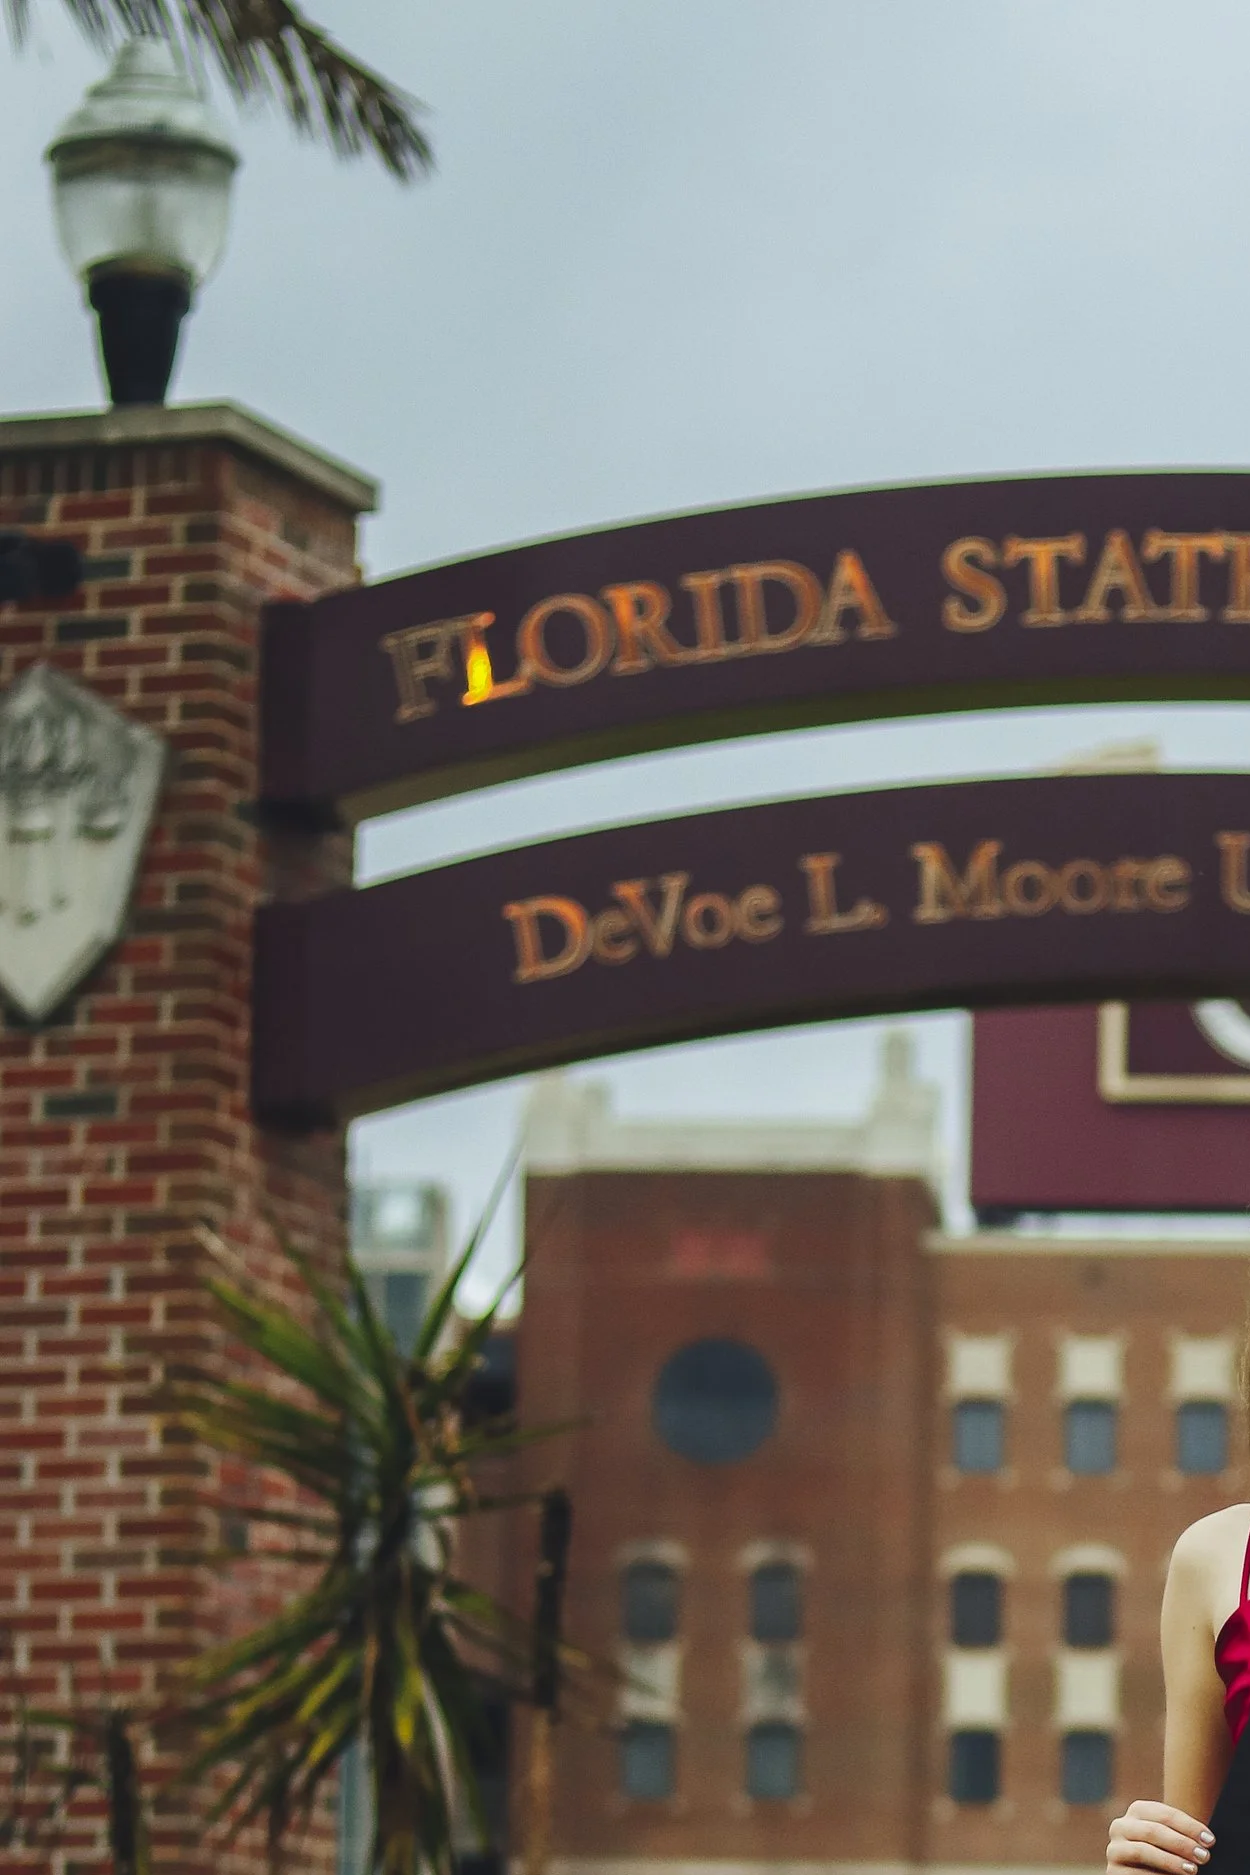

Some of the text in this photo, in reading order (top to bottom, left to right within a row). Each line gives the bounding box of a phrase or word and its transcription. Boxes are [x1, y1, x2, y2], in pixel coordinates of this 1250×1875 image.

[381, 550, 897, 724] FLORIDA
[503, 872, 783, 985] DeVoe
[911, 840, 1191, 925] Moore
